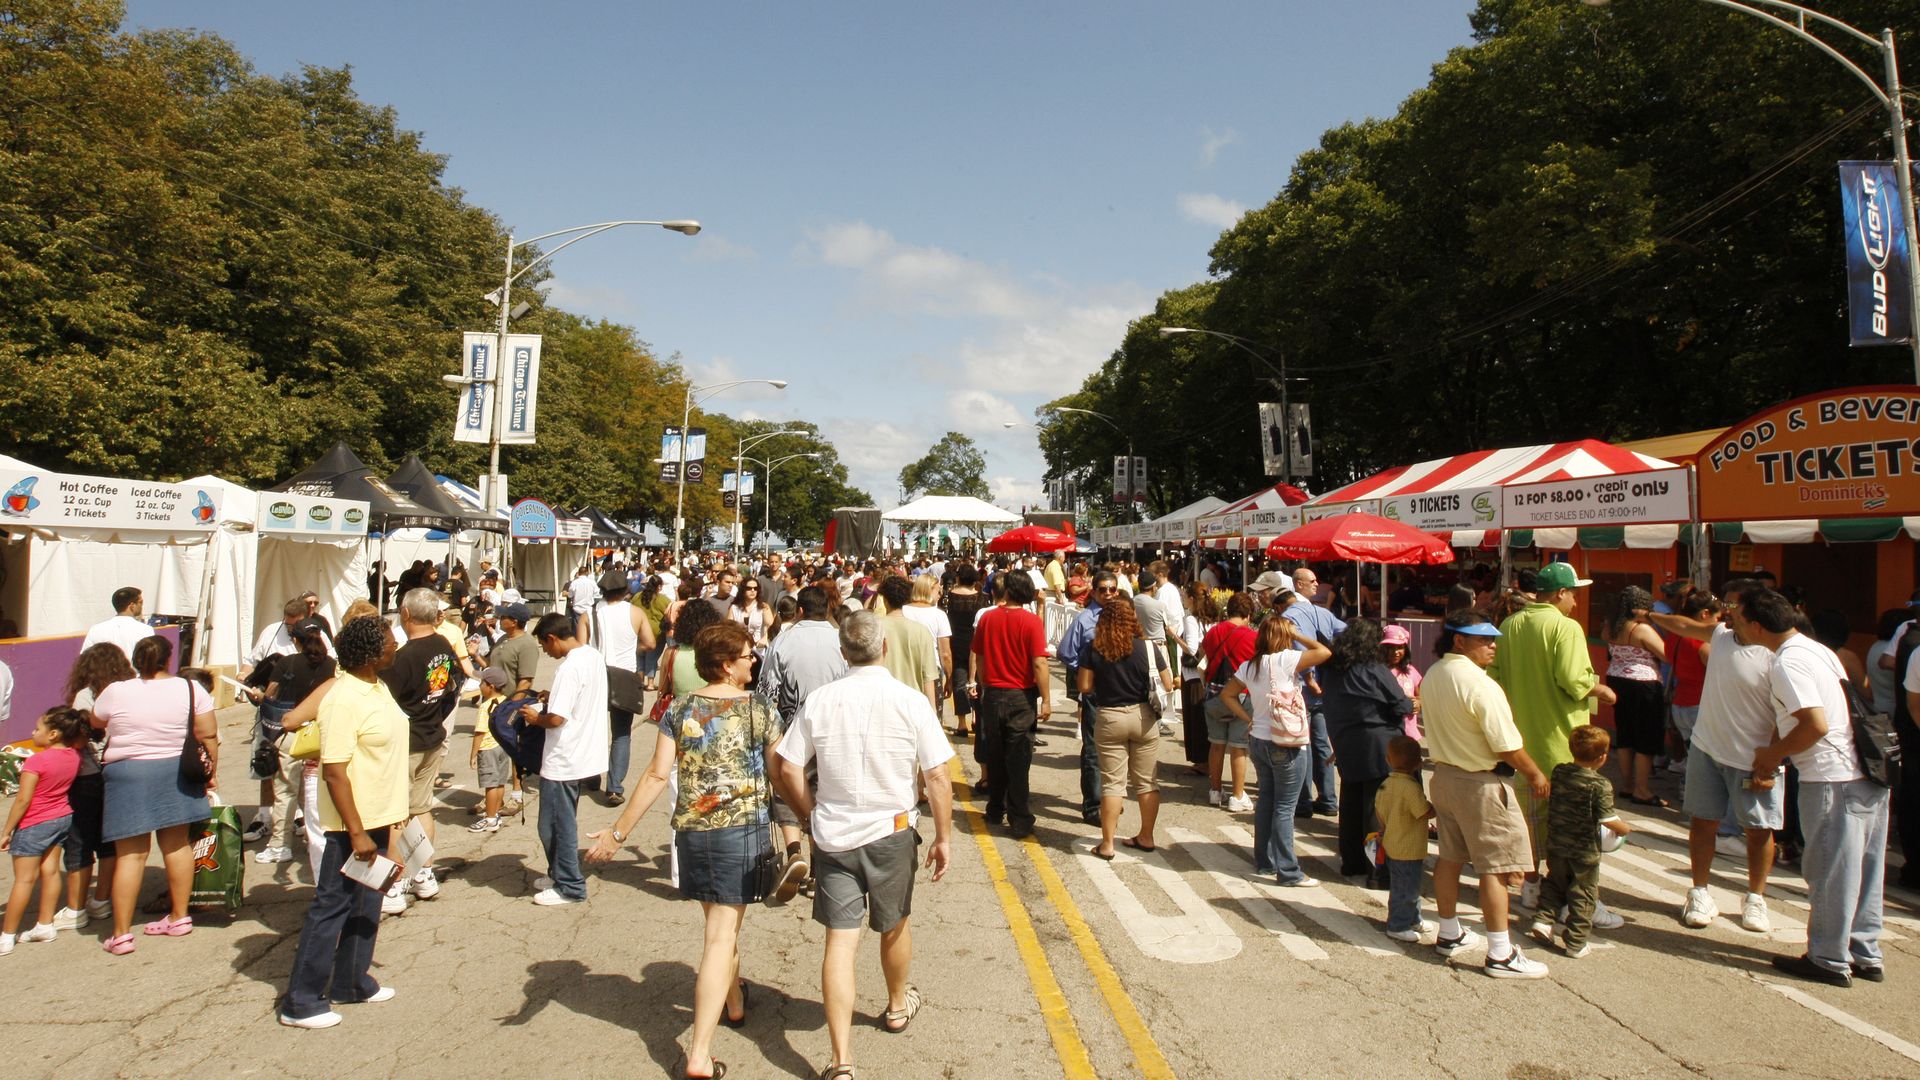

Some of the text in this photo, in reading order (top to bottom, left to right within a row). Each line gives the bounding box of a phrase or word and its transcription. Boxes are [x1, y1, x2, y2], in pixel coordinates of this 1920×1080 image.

[1862, 170, 1887, 337] BUD LIGHT
[474, 347, 486, 386] ribune
[513, 350, 528, 429] Chicago Tribune
[1709, 419, 1776, 472] FOOD
[1787, 408, 1807, 432] &
[59, 481, 118, 495] Hot Coffee
[130, 487, 182, 500] Iced Coffee
[1800, 482, 1886, 501] Dominick's
[63, 495, 112, 508] 12 oz. Cup
[135, 500, 145, 508] 12
[161, 502, 175, 511] Cup
[1410, 494, 1460, 514] 9 TICKETS
[1514, 494, 1524, 506] 12
[1527, 492, 1548, 505] FOR
[1551, 489, 1583, 503] $8.00
[64, 508, 107, 518] 2 Tickets
[136, 511, 171, 521] 3 Tickets
[515, 504, 551, 520] GOVERNMENT
[1256, 512, 1275, 525] TICKETS
[1530, 511, 1552, 522] TICKET
[1554, 510, 1577, 521] SALES
[1579, 509, 1596, 520] END
[1598, 508, 1608, 518] AT
[1632, 506, 1647, 517] PM
[521, 521, 547, 532] SERVICES
[192, 834, 217, 851] AKER
